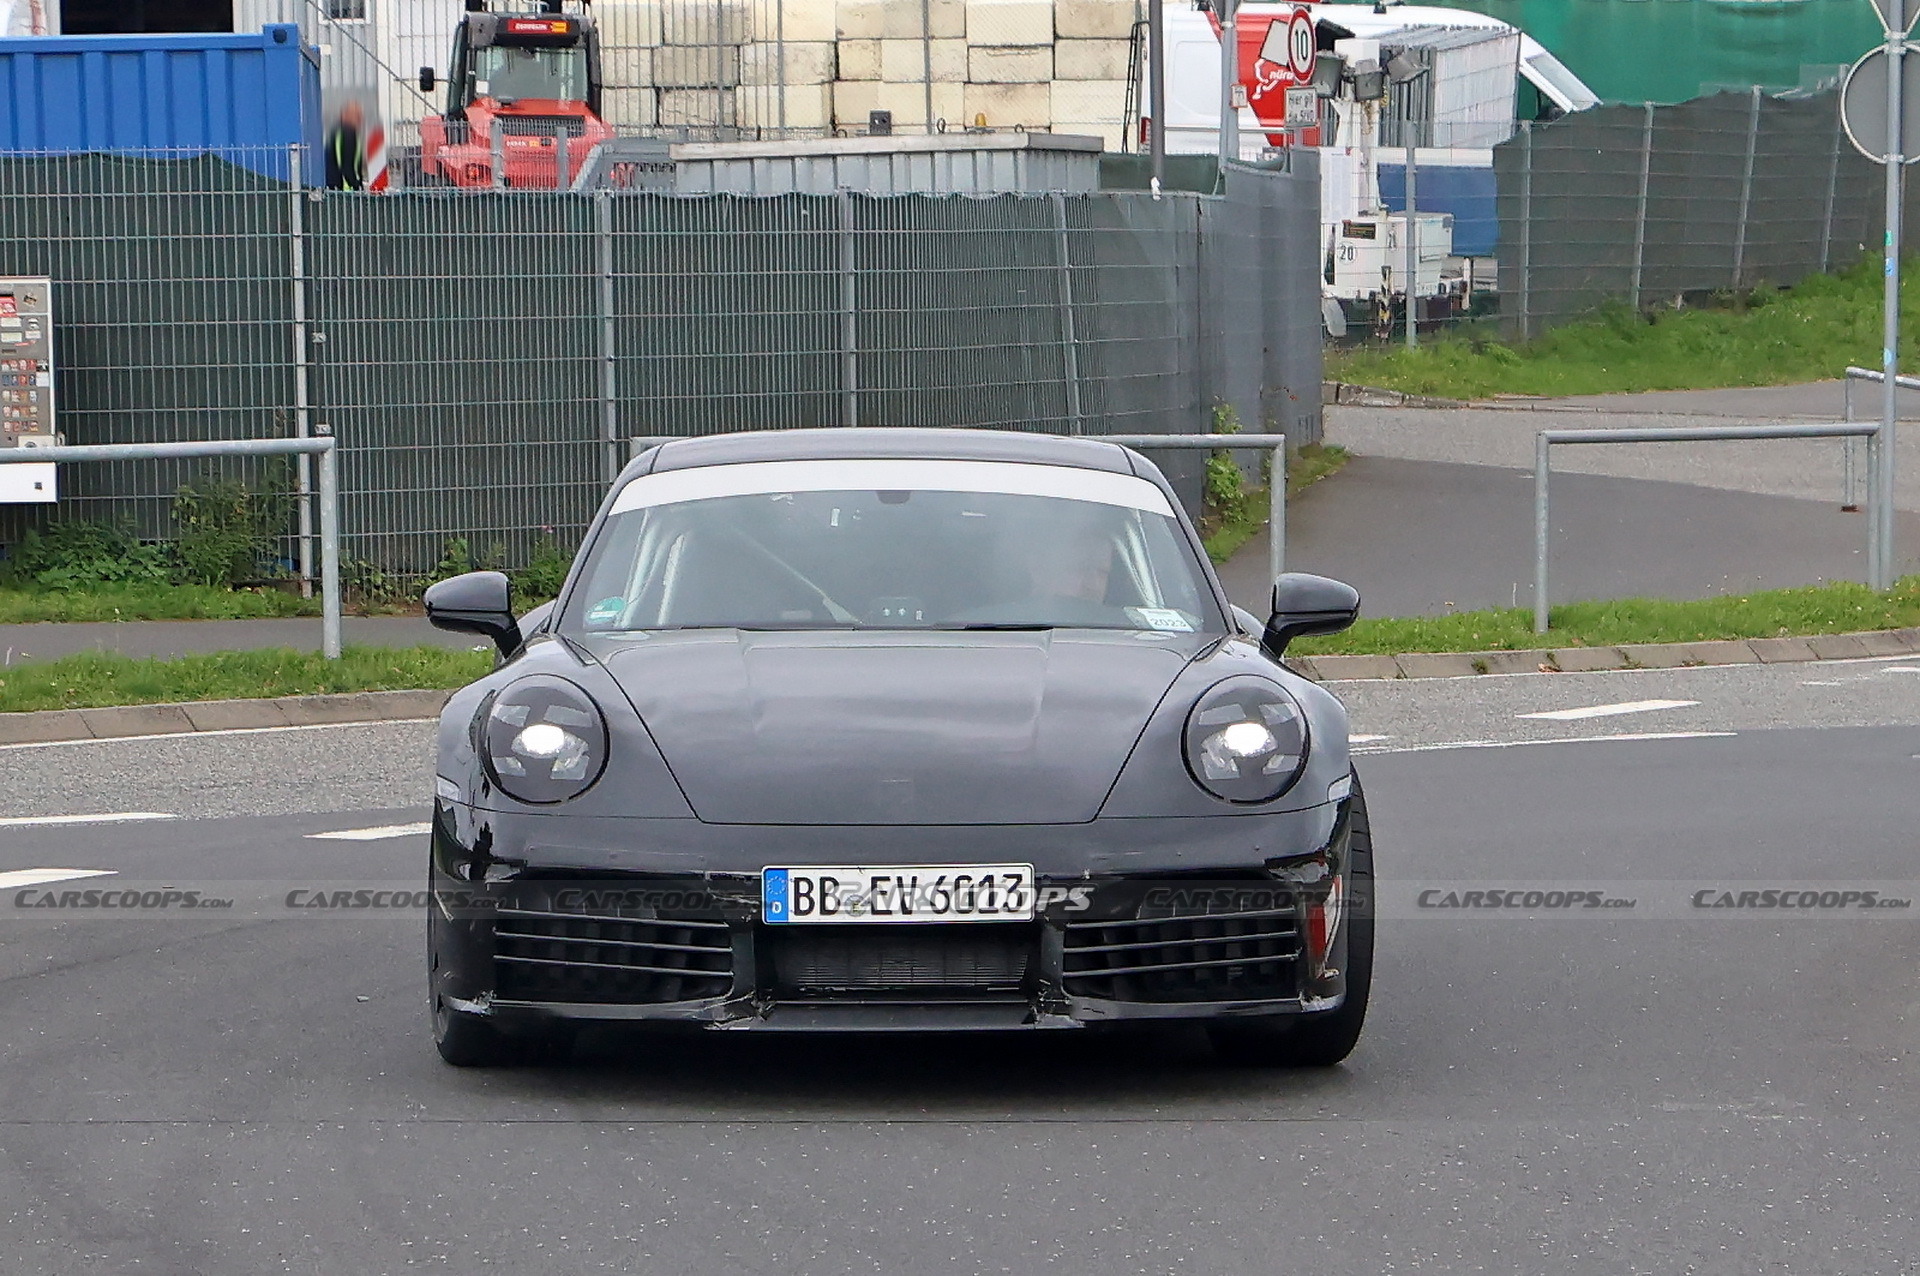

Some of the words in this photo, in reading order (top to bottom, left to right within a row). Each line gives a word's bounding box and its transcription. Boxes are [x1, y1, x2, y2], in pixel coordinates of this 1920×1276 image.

[1294, 29, 1309, 61] 10
[1340, 244, 1354, 261] 20
[771, 901, 782, 914] D
[793, 876, 842, 916] BB
[870, 875, 919, 915] EV
